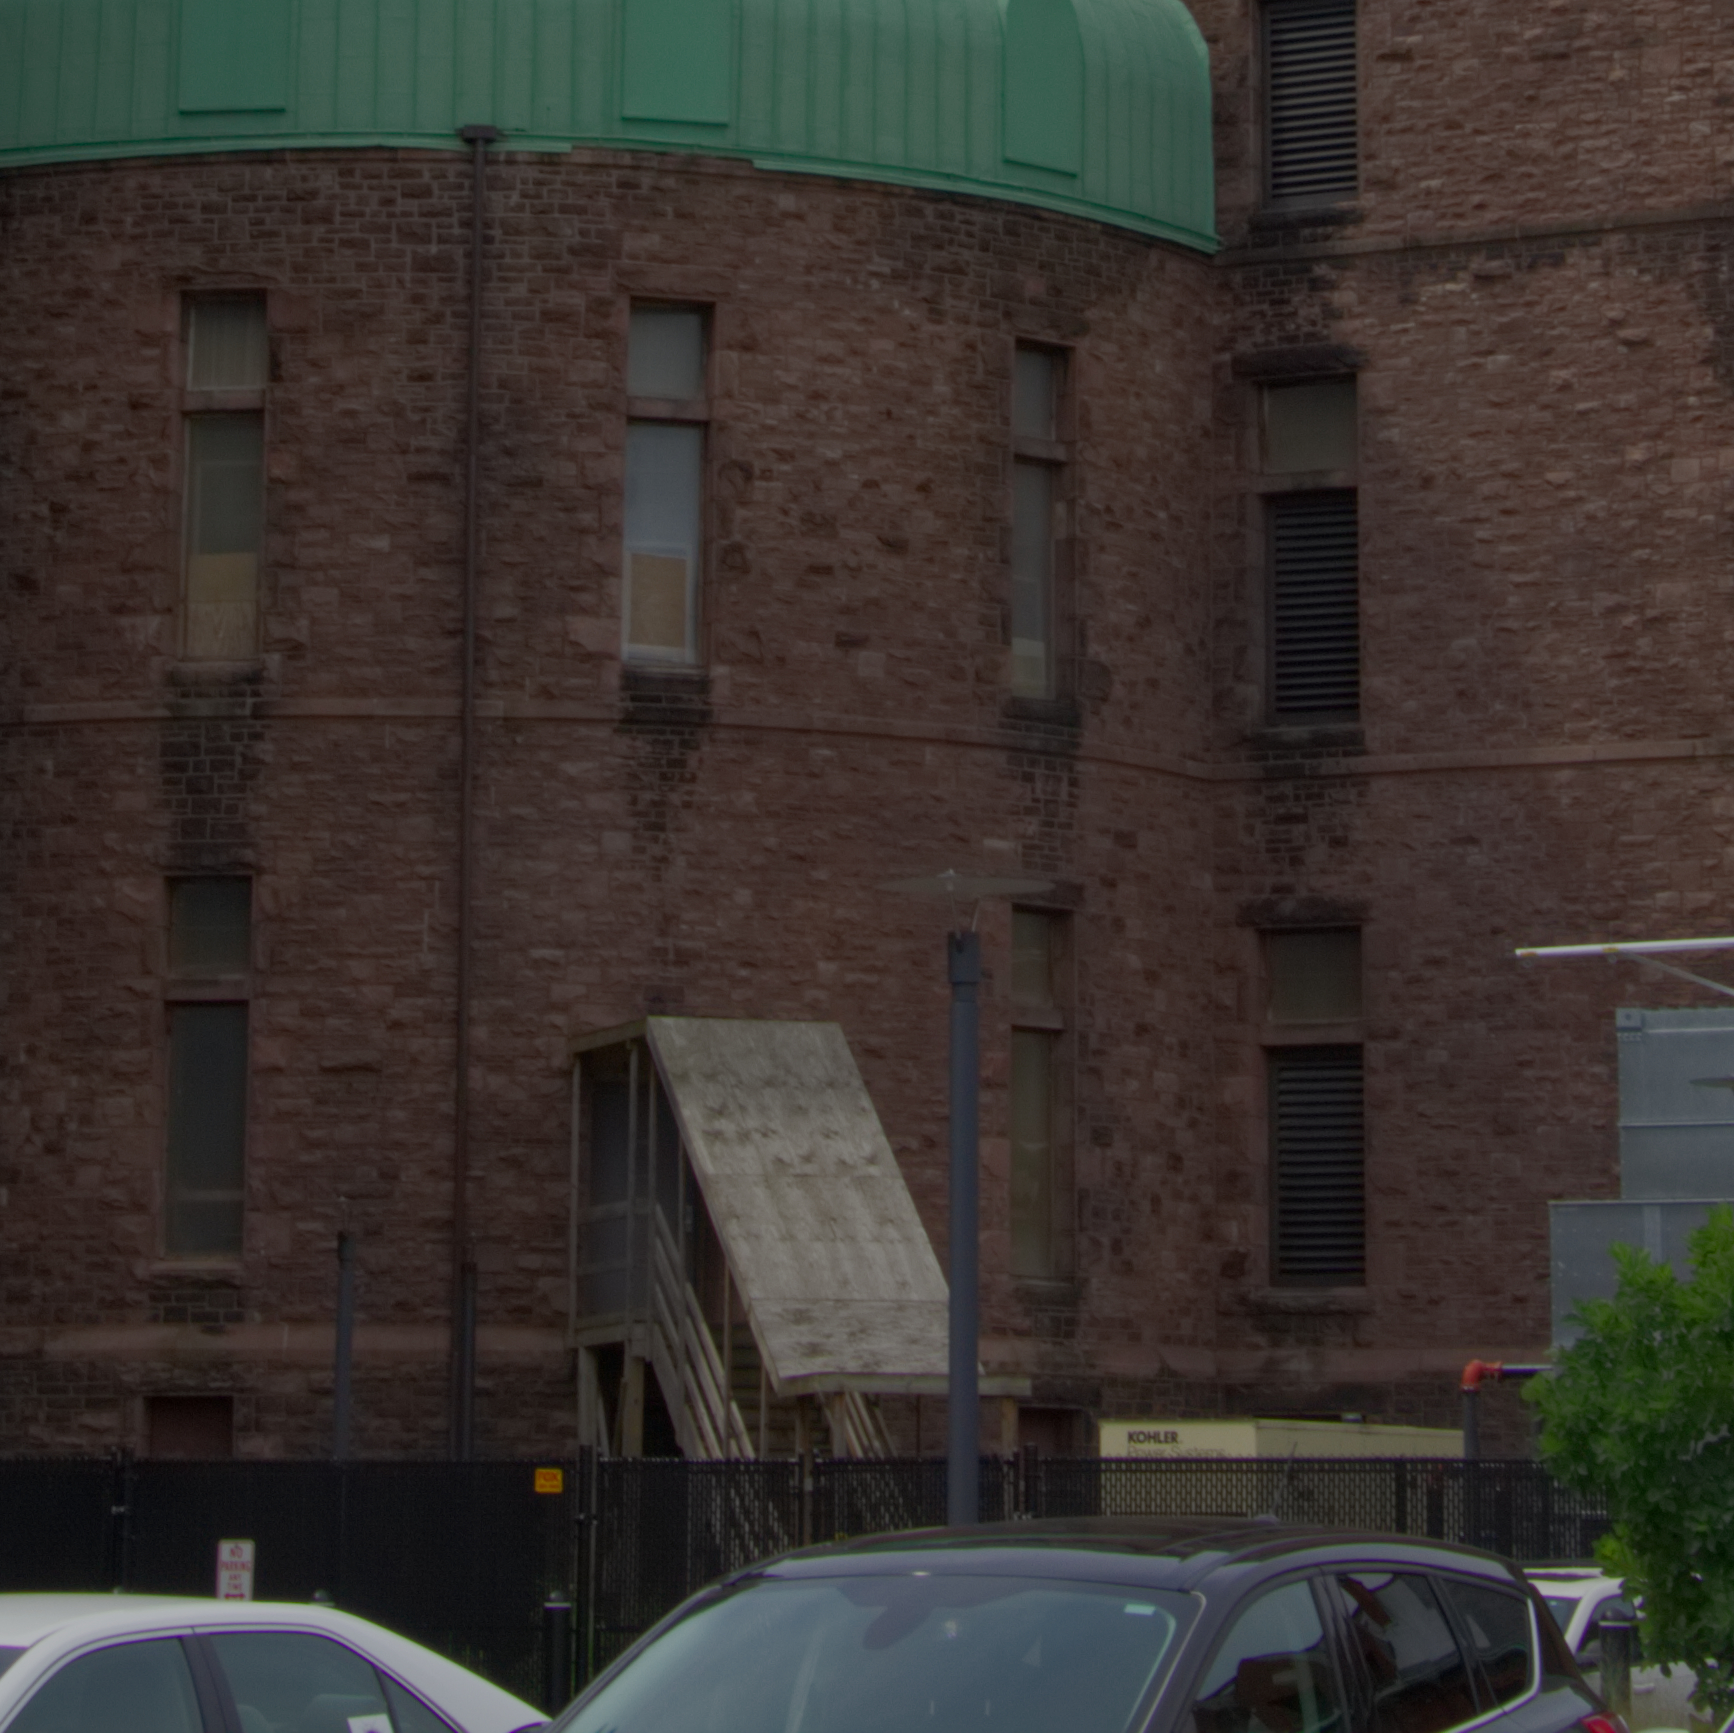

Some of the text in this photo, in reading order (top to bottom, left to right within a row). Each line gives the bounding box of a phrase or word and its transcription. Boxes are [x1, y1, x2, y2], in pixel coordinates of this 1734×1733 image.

[1127, 1431, 1179, 1444] KOHLER
[229, 1546, 243, 1558] NO
[220, 1560, 251, 1572] PARKING
